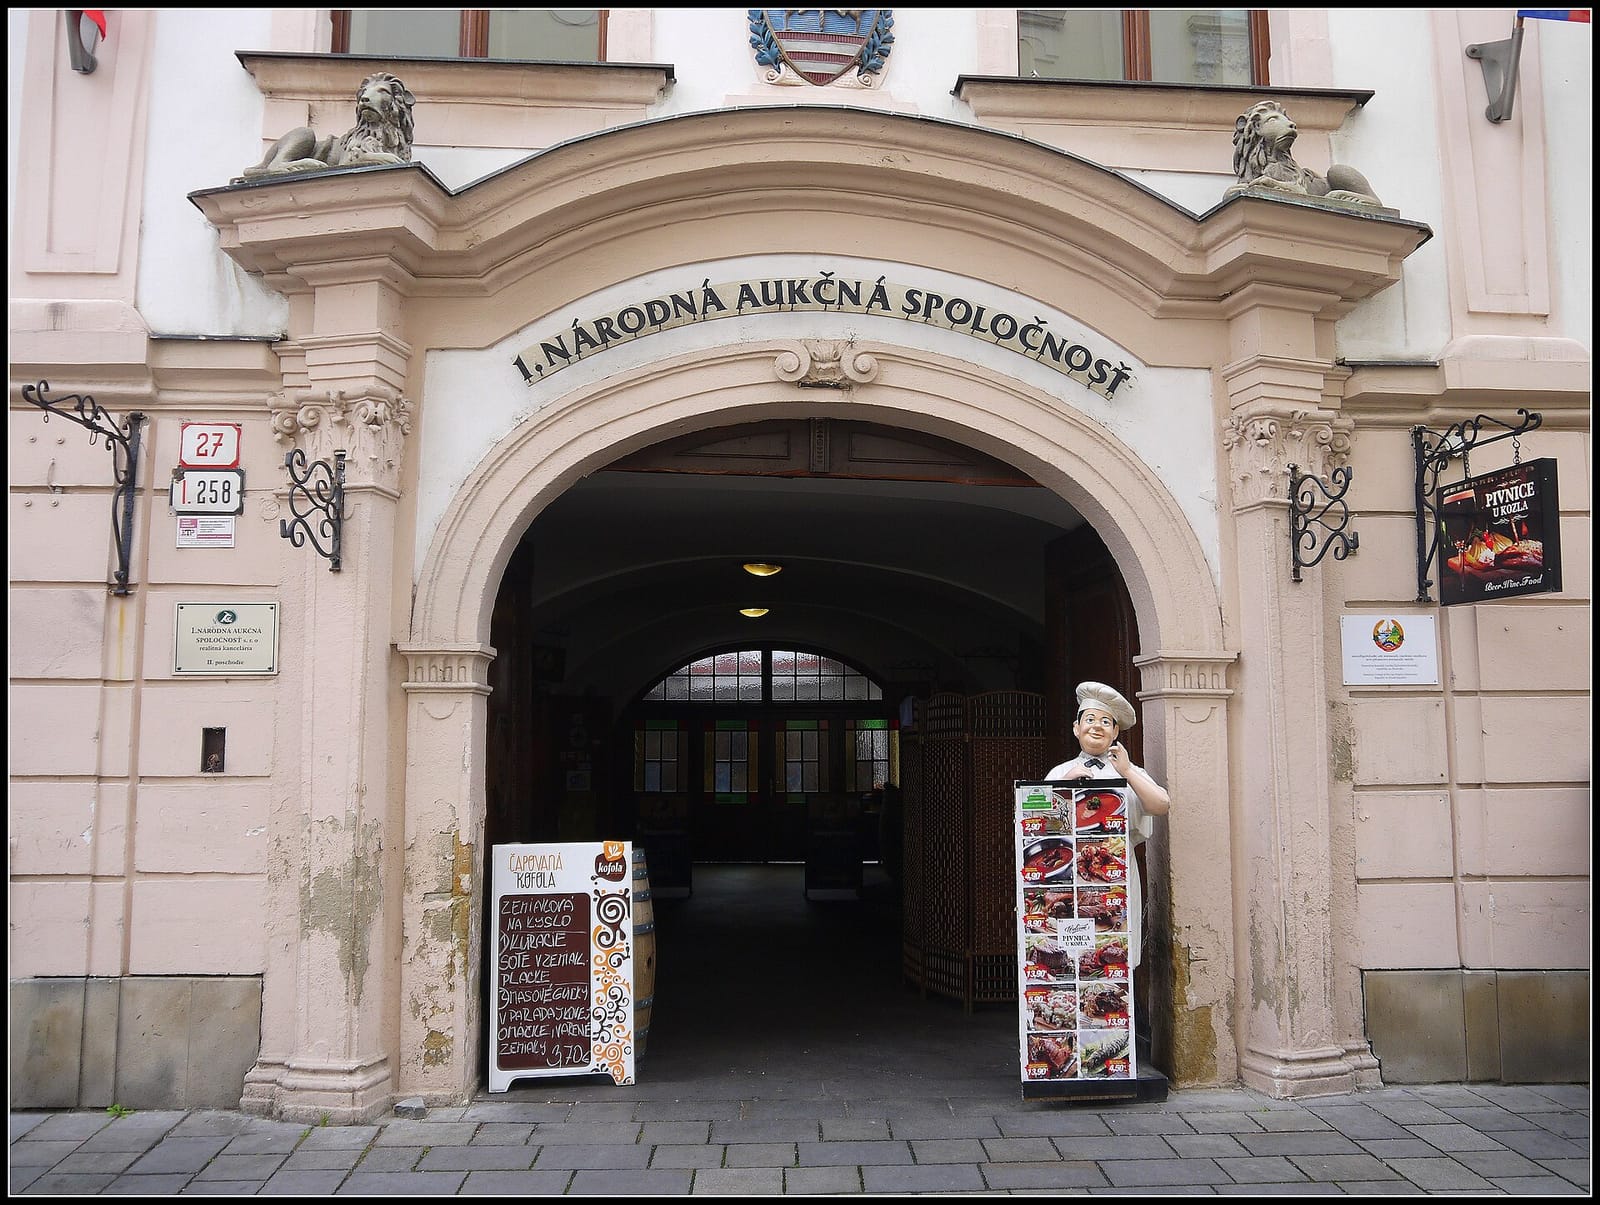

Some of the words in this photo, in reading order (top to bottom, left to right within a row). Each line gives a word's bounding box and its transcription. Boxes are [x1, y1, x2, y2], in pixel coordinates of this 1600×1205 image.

[737, 271, 891, 311] AUKČNÁ
[902, 289, 1133, 395] SPOLOČNOSŤ
[196, 433, 223, 457] 27
[1485, 482, 1535, 507] PIVNICE
[1492, 507, 1499, 517] U
[1501, 501, 1528, 516] KOZLA
[509, 852, 563, 872] ČAPOVANÁ
[598, 862, 623, 875] kofola
[513, 871, 556, 888] KOFOLA
[507, 918, 522, 931] NA
[526, 914, 571, 928] KYSLO
[499, 1012, 506, 1024] V
